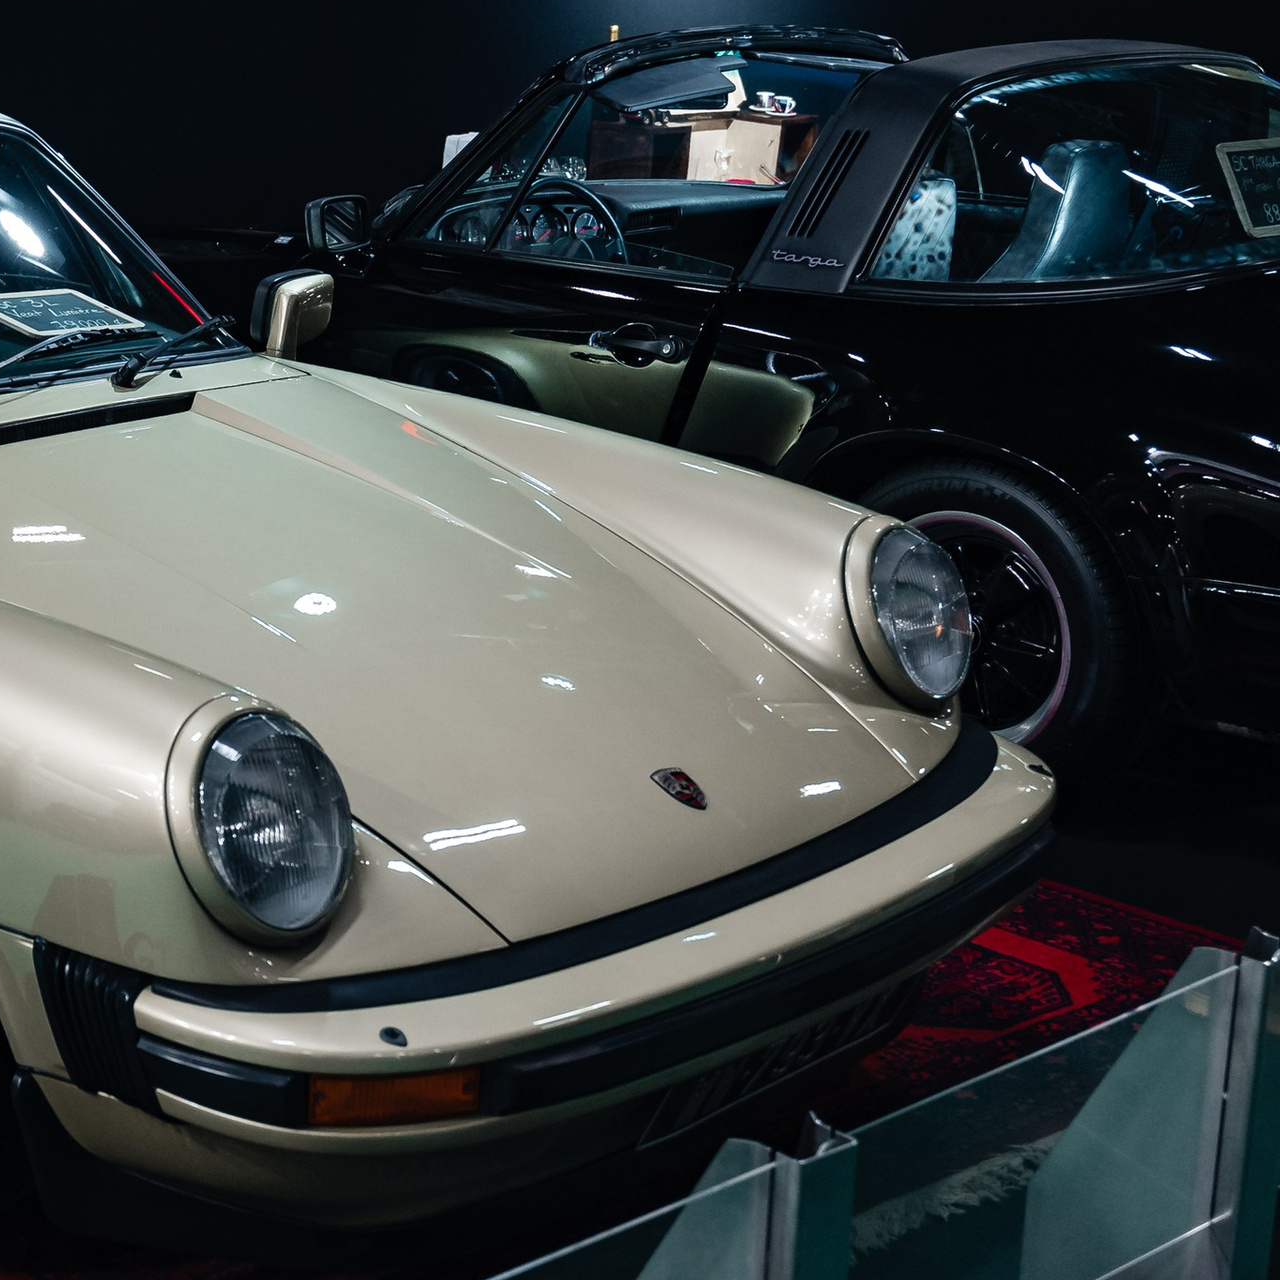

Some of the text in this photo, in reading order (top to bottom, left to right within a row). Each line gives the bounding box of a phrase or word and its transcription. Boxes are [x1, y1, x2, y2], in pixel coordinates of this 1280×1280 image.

[1232, 154, 1248, 172] SC
[772, 250, 845, 267] targa
[4, 306, 105, 319] Vert Lumière
